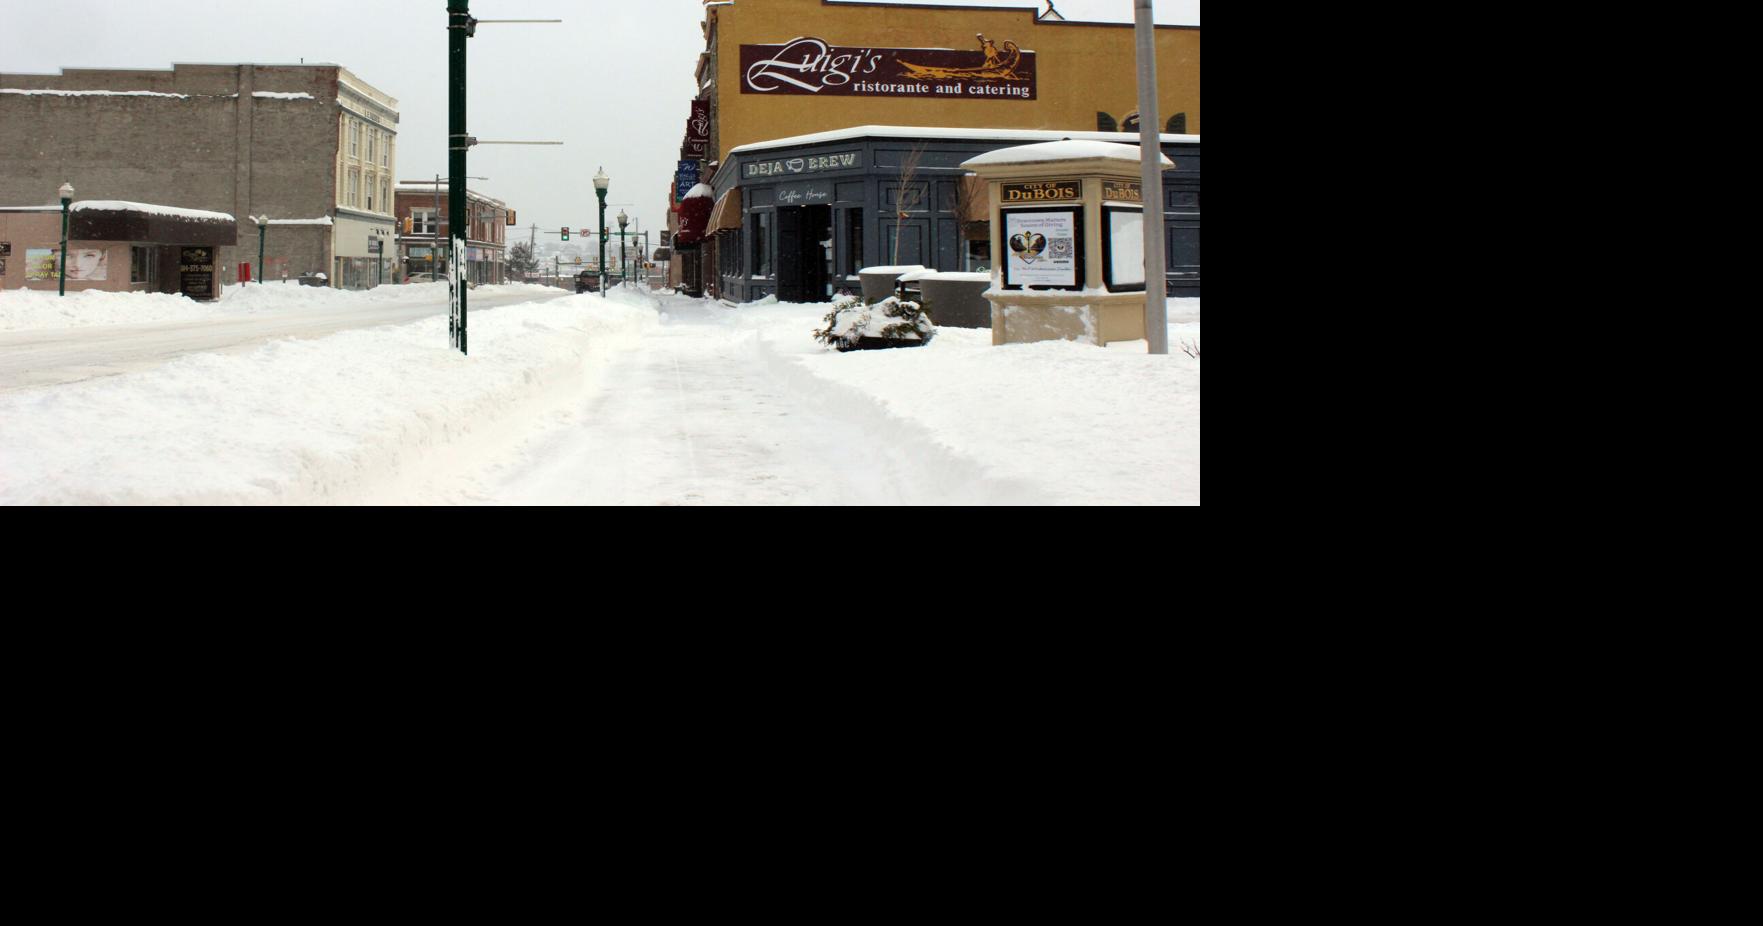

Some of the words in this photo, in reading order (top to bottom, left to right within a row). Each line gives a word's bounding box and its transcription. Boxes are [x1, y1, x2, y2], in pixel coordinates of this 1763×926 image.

[747, 37, 882, 92] Luigi's
[854, 80, 929, 93] ristorante
[935, 82, 962, 94] and
[968, 83, 1030, 97] catering
[749, 162, 783, 175] DEJA
[808, 154, 856, 169] BREW
[779, 190, 802, 203] Coffee
[805, 188, 827, 200] House
[1008, 187, 1075, 200] DuBOIS
[1105, 187, 1139, 199] DuBOIS
